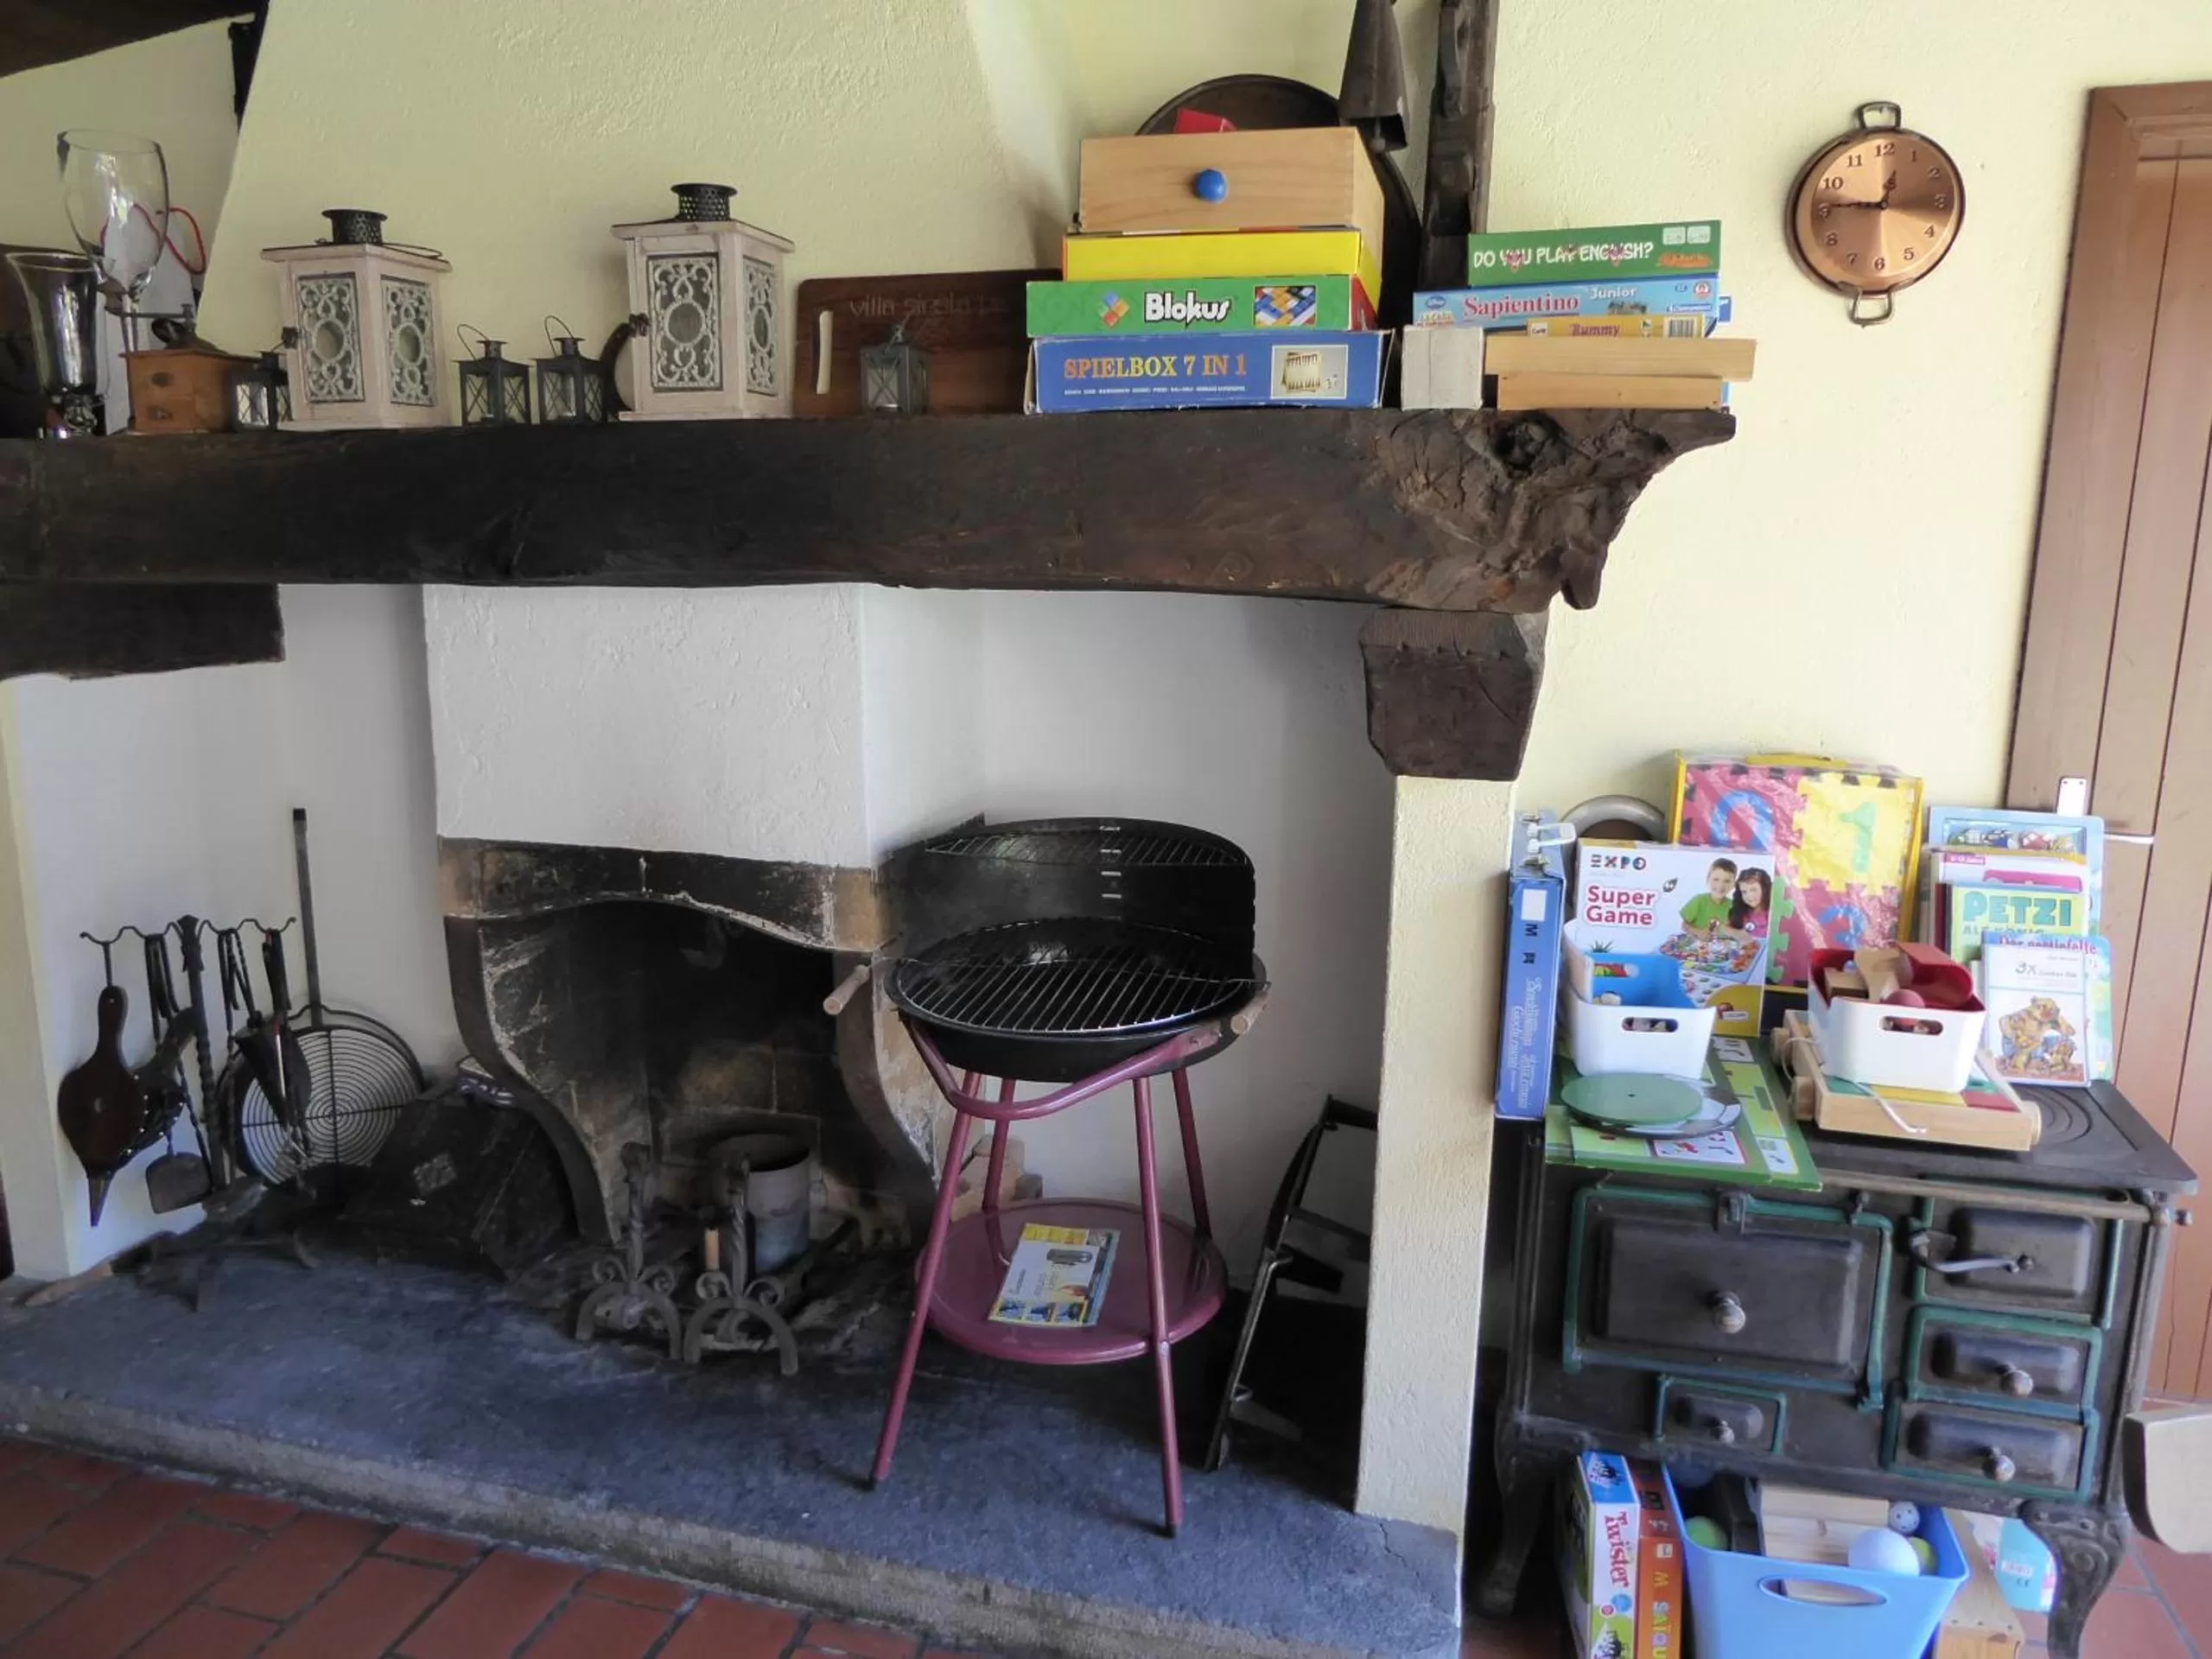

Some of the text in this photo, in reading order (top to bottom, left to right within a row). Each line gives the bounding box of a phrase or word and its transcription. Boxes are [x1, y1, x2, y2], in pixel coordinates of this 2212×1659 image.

[1874, 142, 1896, 157] 12
[1910, 149, 1918, 163] 1
[1847, 154, 1863, 168] 11
[1928, 167, 1941, 180] 2
[1821, 176, 1844, 190] 10
[1934, 194, 1946, 209] 3
[1818, 203, 1830, 219] 9
[1826, 232, 1839, 246] 8
[1923, 225, 1936, 239] 4
[1473, 250, 1496, 269] DO
[1499, 248, 1532, 266] YOU
[1535, 243, 1578, 264] PLAY
[1846, 252, 1858, 266] 7
[1903, 247, 1916, 261] 5
[1873, 257, 1886, 270] 6
[1144, 289, 1231, 327] Blokus
[1464, 292, 1580, 319] Sapientino
[1589, 285, 1638, 301] Junior
[1064, 353, 1247, 378] SPIELBOX 7 IN 1
[1590, 854, 1647, 871] EXPO
[1587, 885, 1656, 908] Super
[1586, 905, 1653, 925] Game
[1962, 891, 2073, 927] PETZI
[1604, 1510, 1630, 1589] Twister
